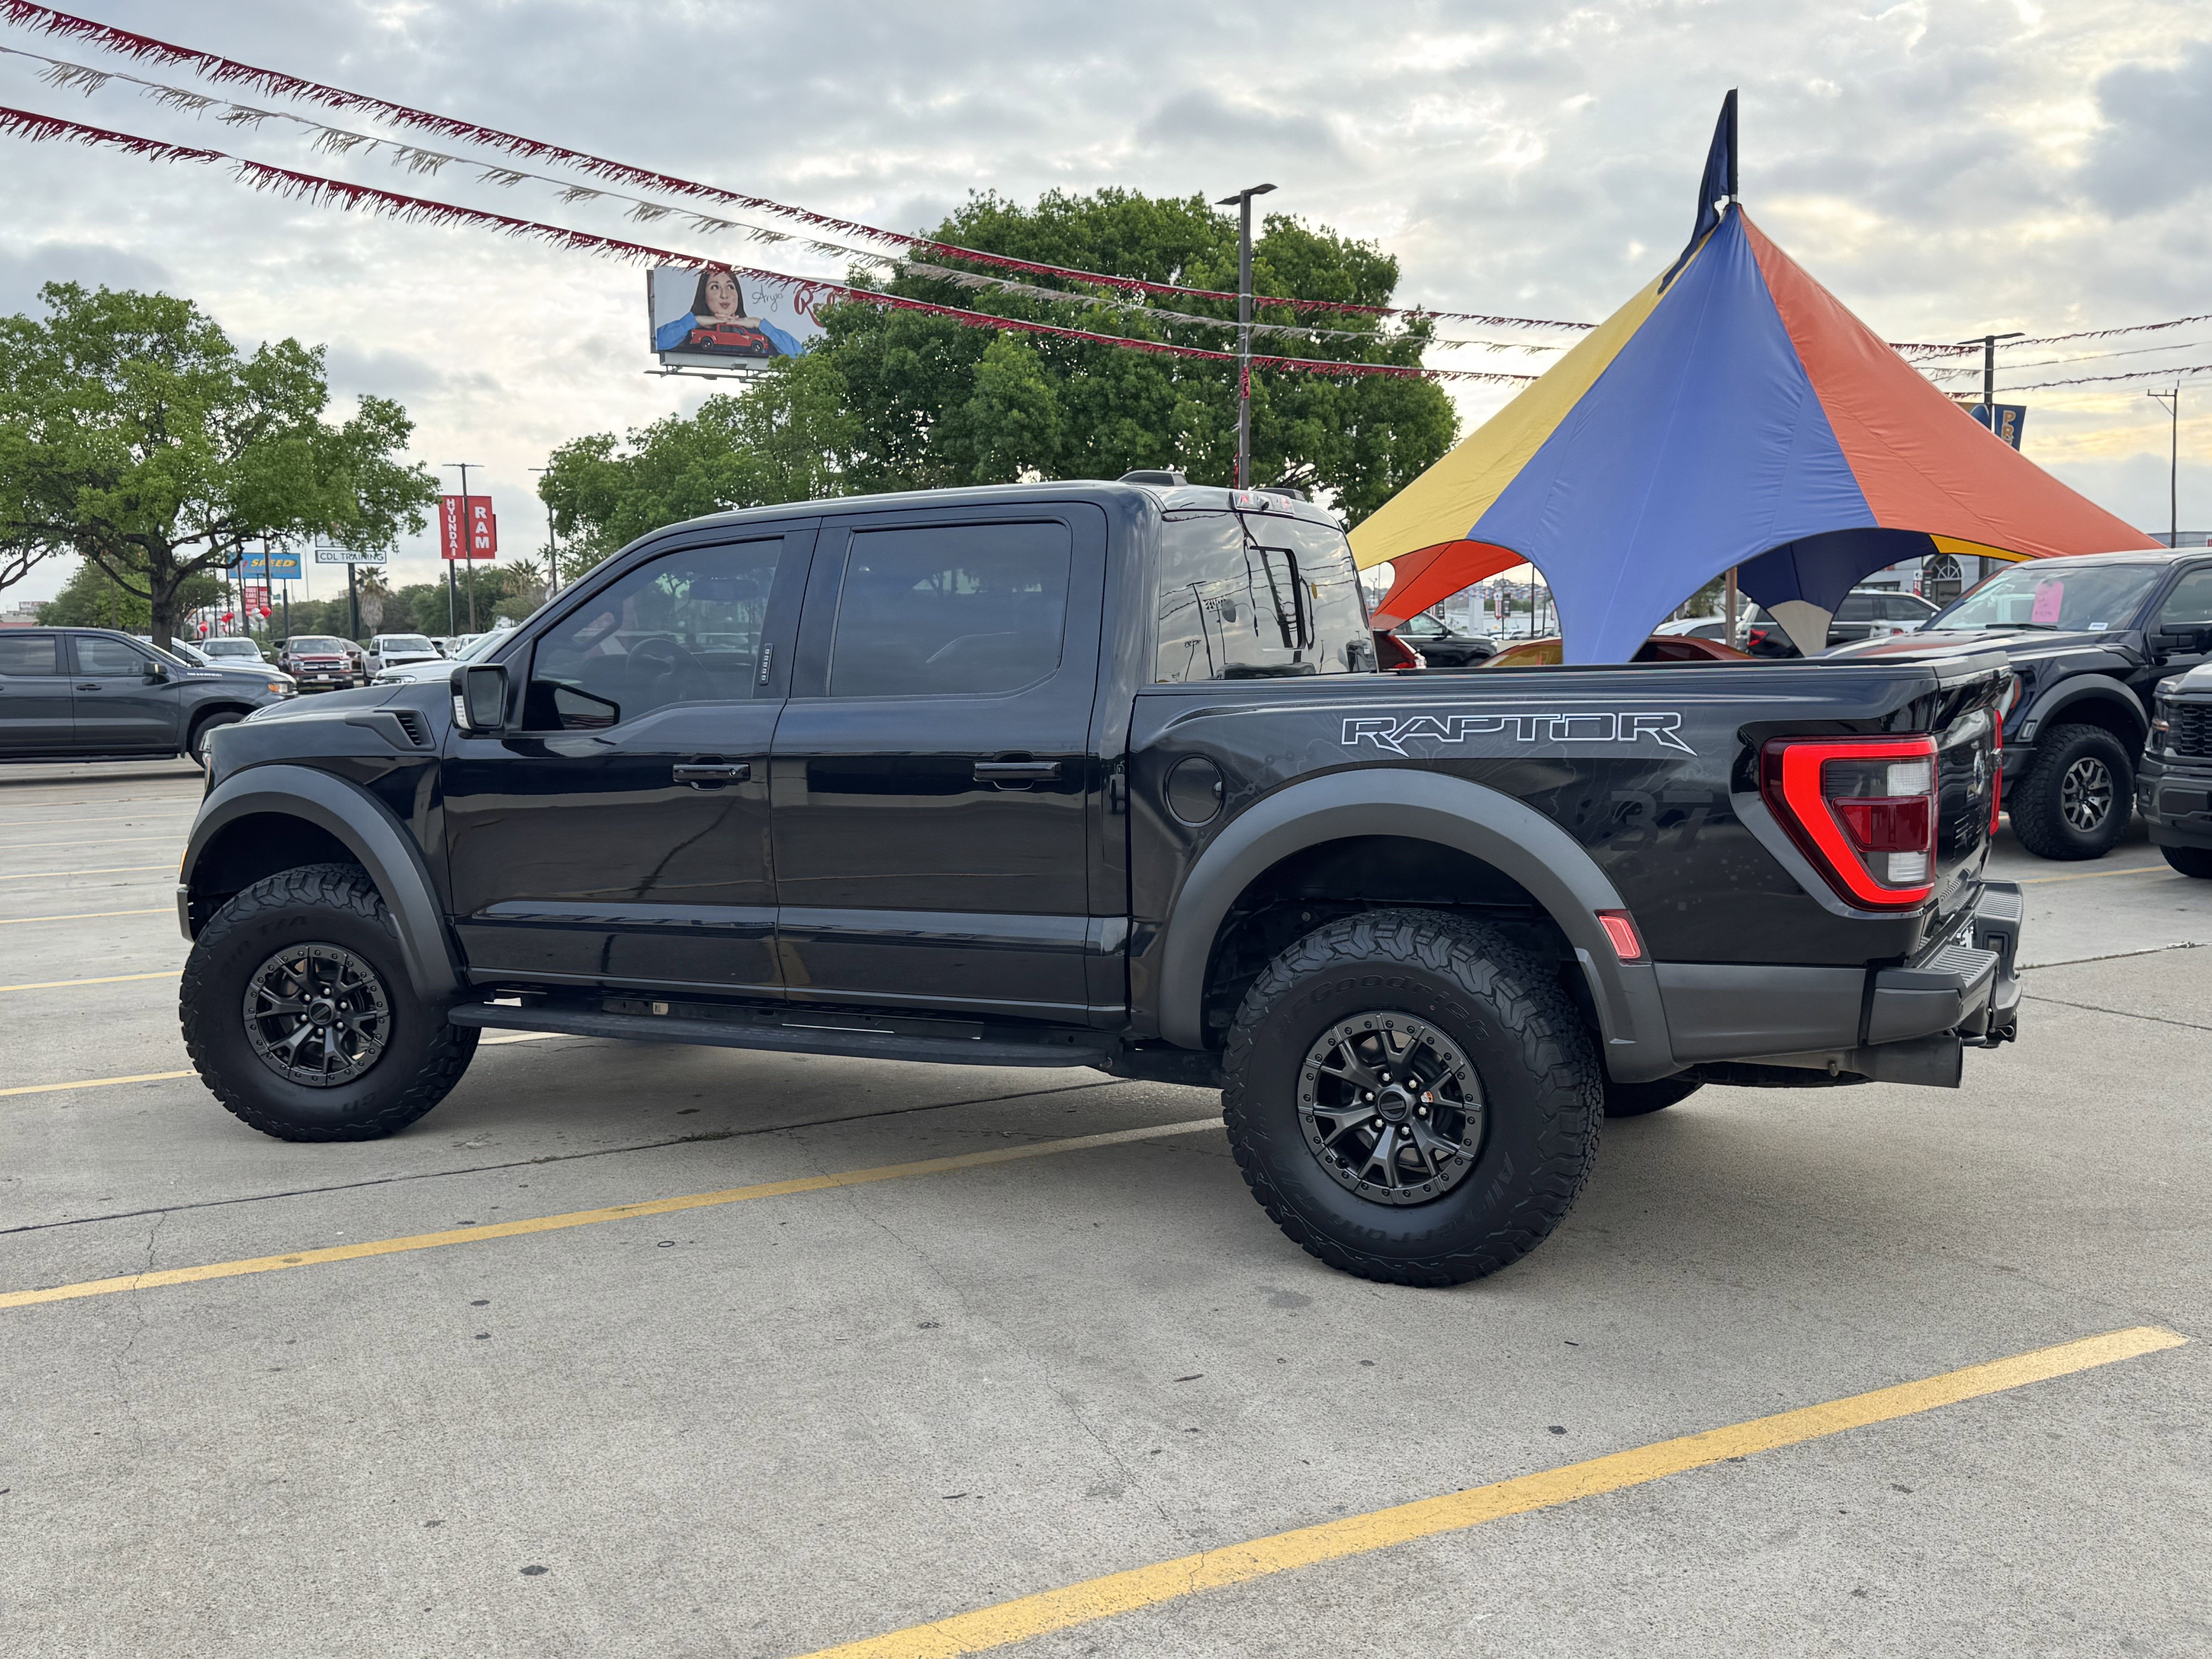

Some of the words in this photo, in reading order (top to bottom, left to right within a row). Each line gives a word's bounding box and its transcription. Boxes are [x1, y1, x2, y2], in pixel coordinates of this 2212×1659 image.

[447, 498, 458, 556] HYUNDAI
[474, 506, 489, 549] RAM
[1341, 712, 1698, 757] RAPTOR
[1610, 791, 1713, 852] 37
